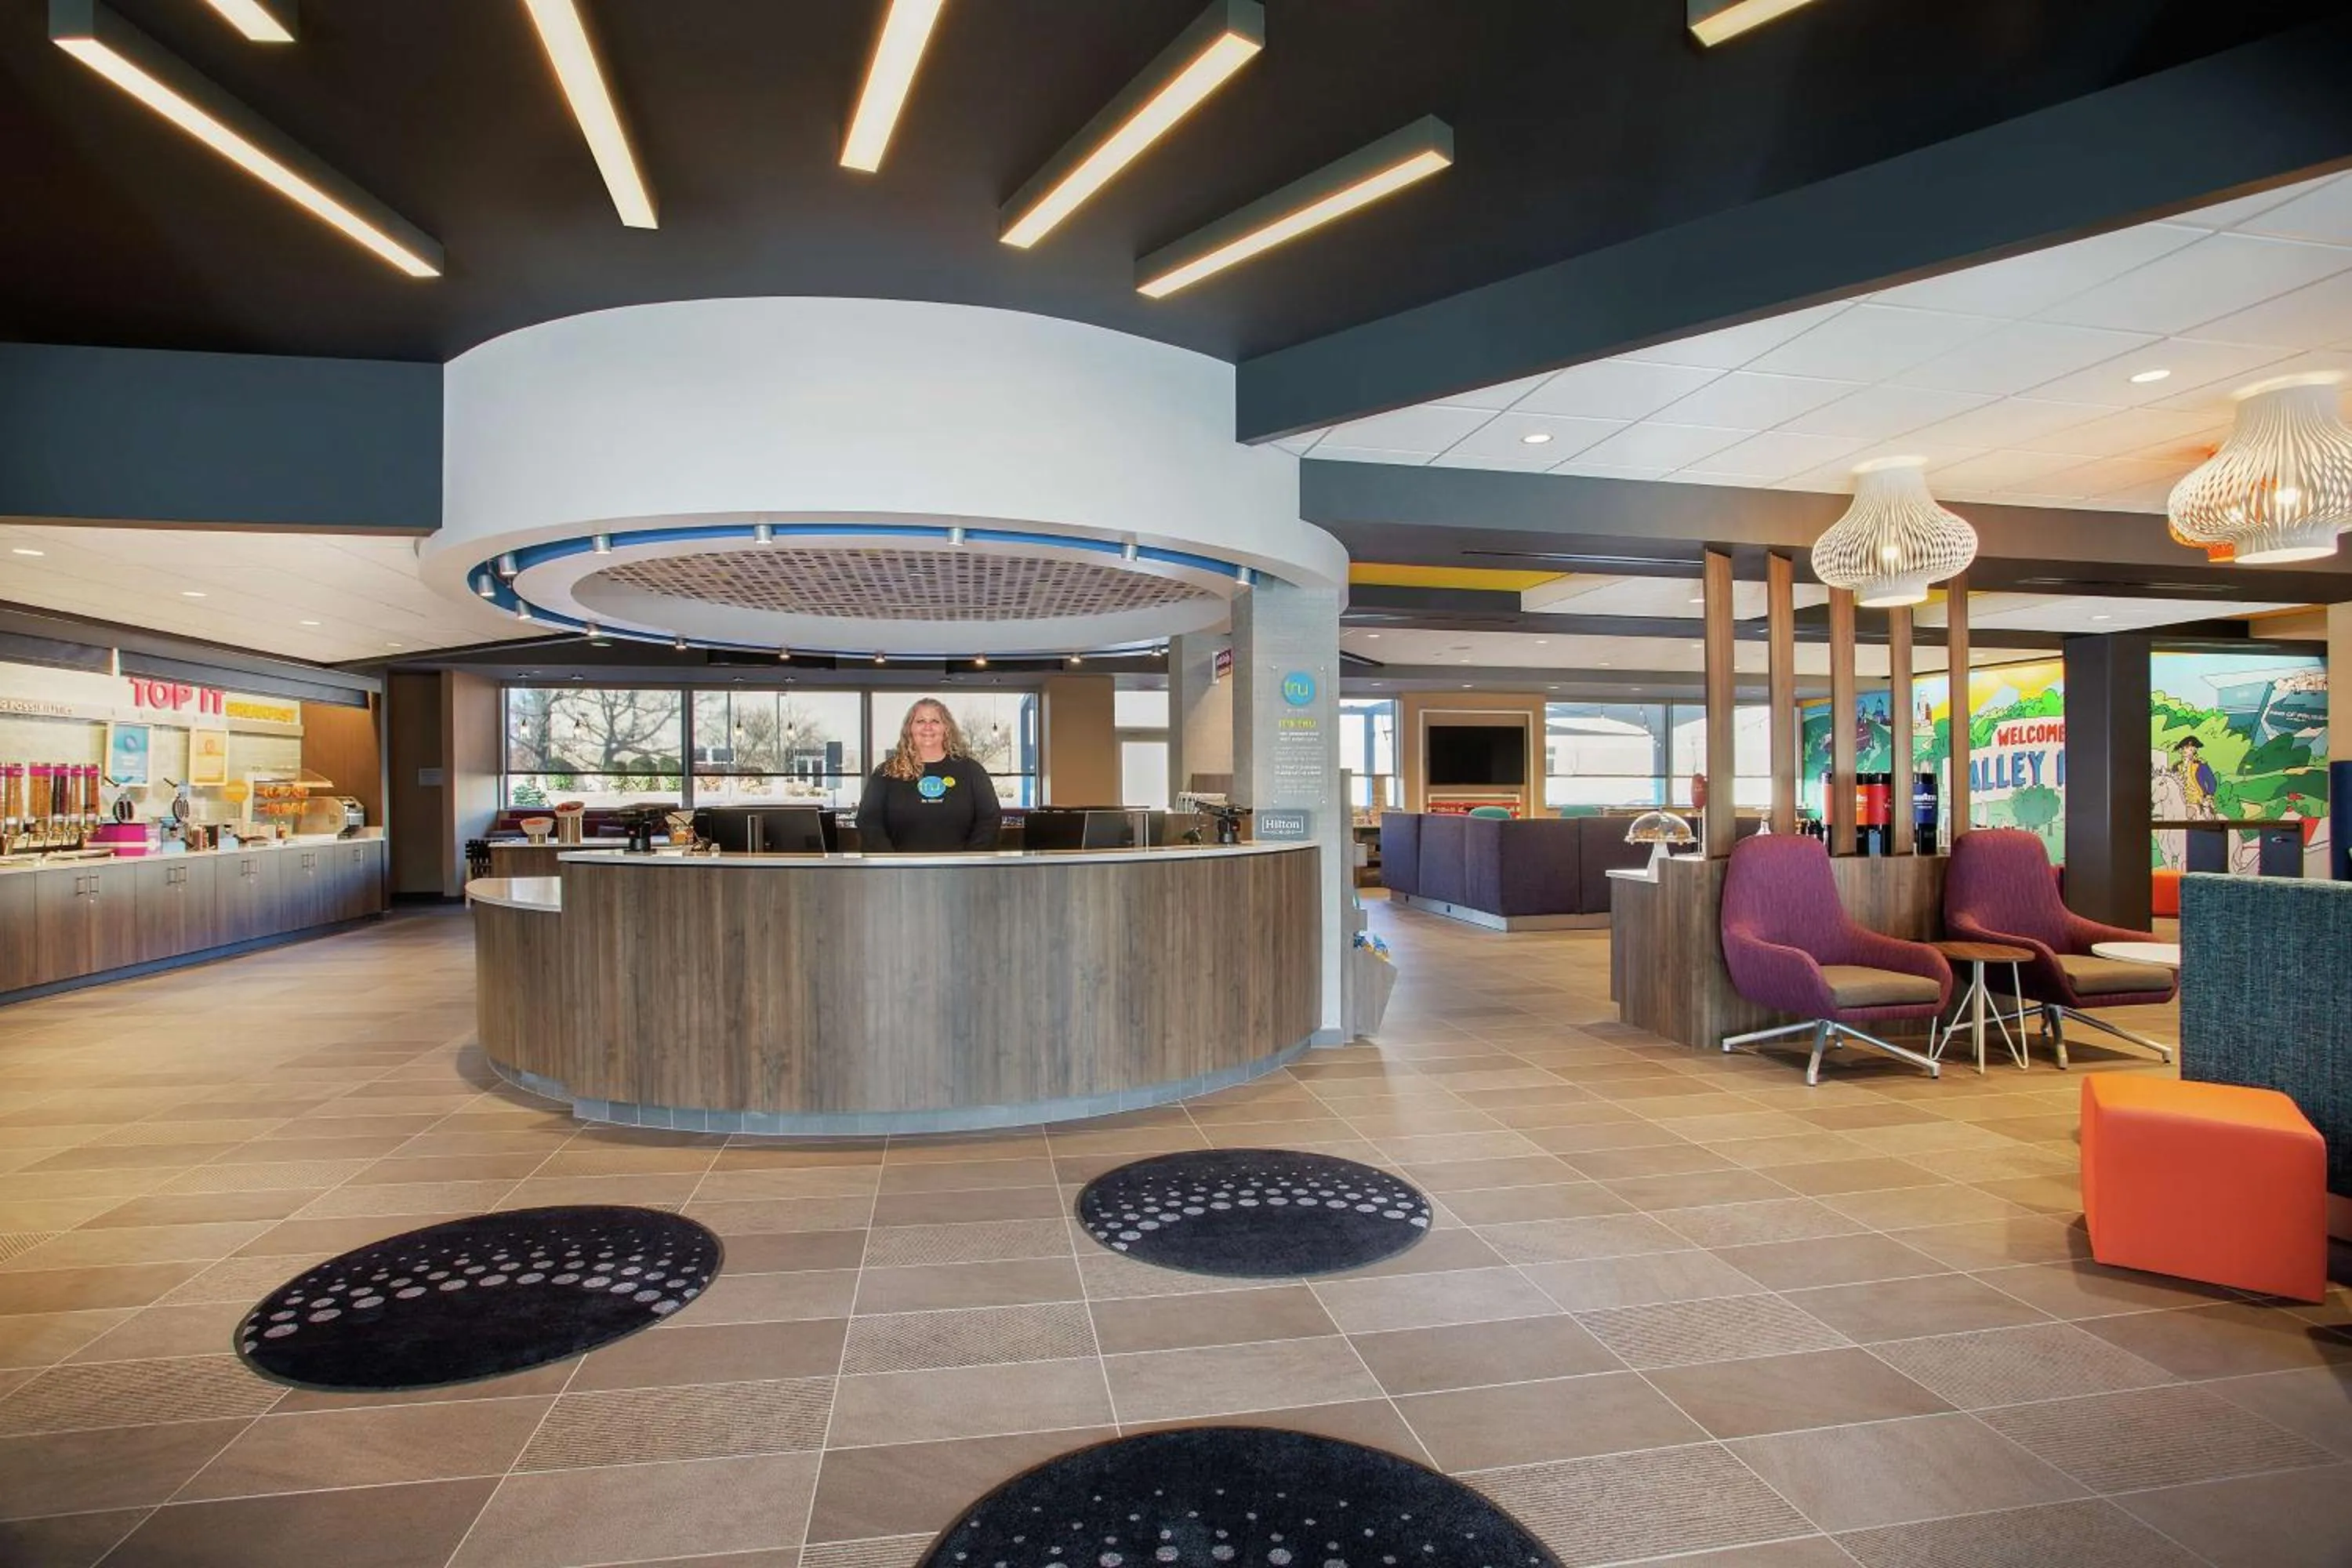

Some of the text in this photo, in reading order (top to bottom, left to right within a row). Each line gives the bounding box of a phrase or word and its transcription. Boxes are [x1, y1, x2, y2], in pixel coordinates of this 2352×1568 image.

[129, 677, 194, 710] TOP
[199, 687, 227, 715] IT
[1284, 681, 1308, 697] tru
[1997, 724, 2065, 746] WELCOME
[1969, 750, 2045, 793] ALLEY
[1265, 818, 1300, 829] Hilton
